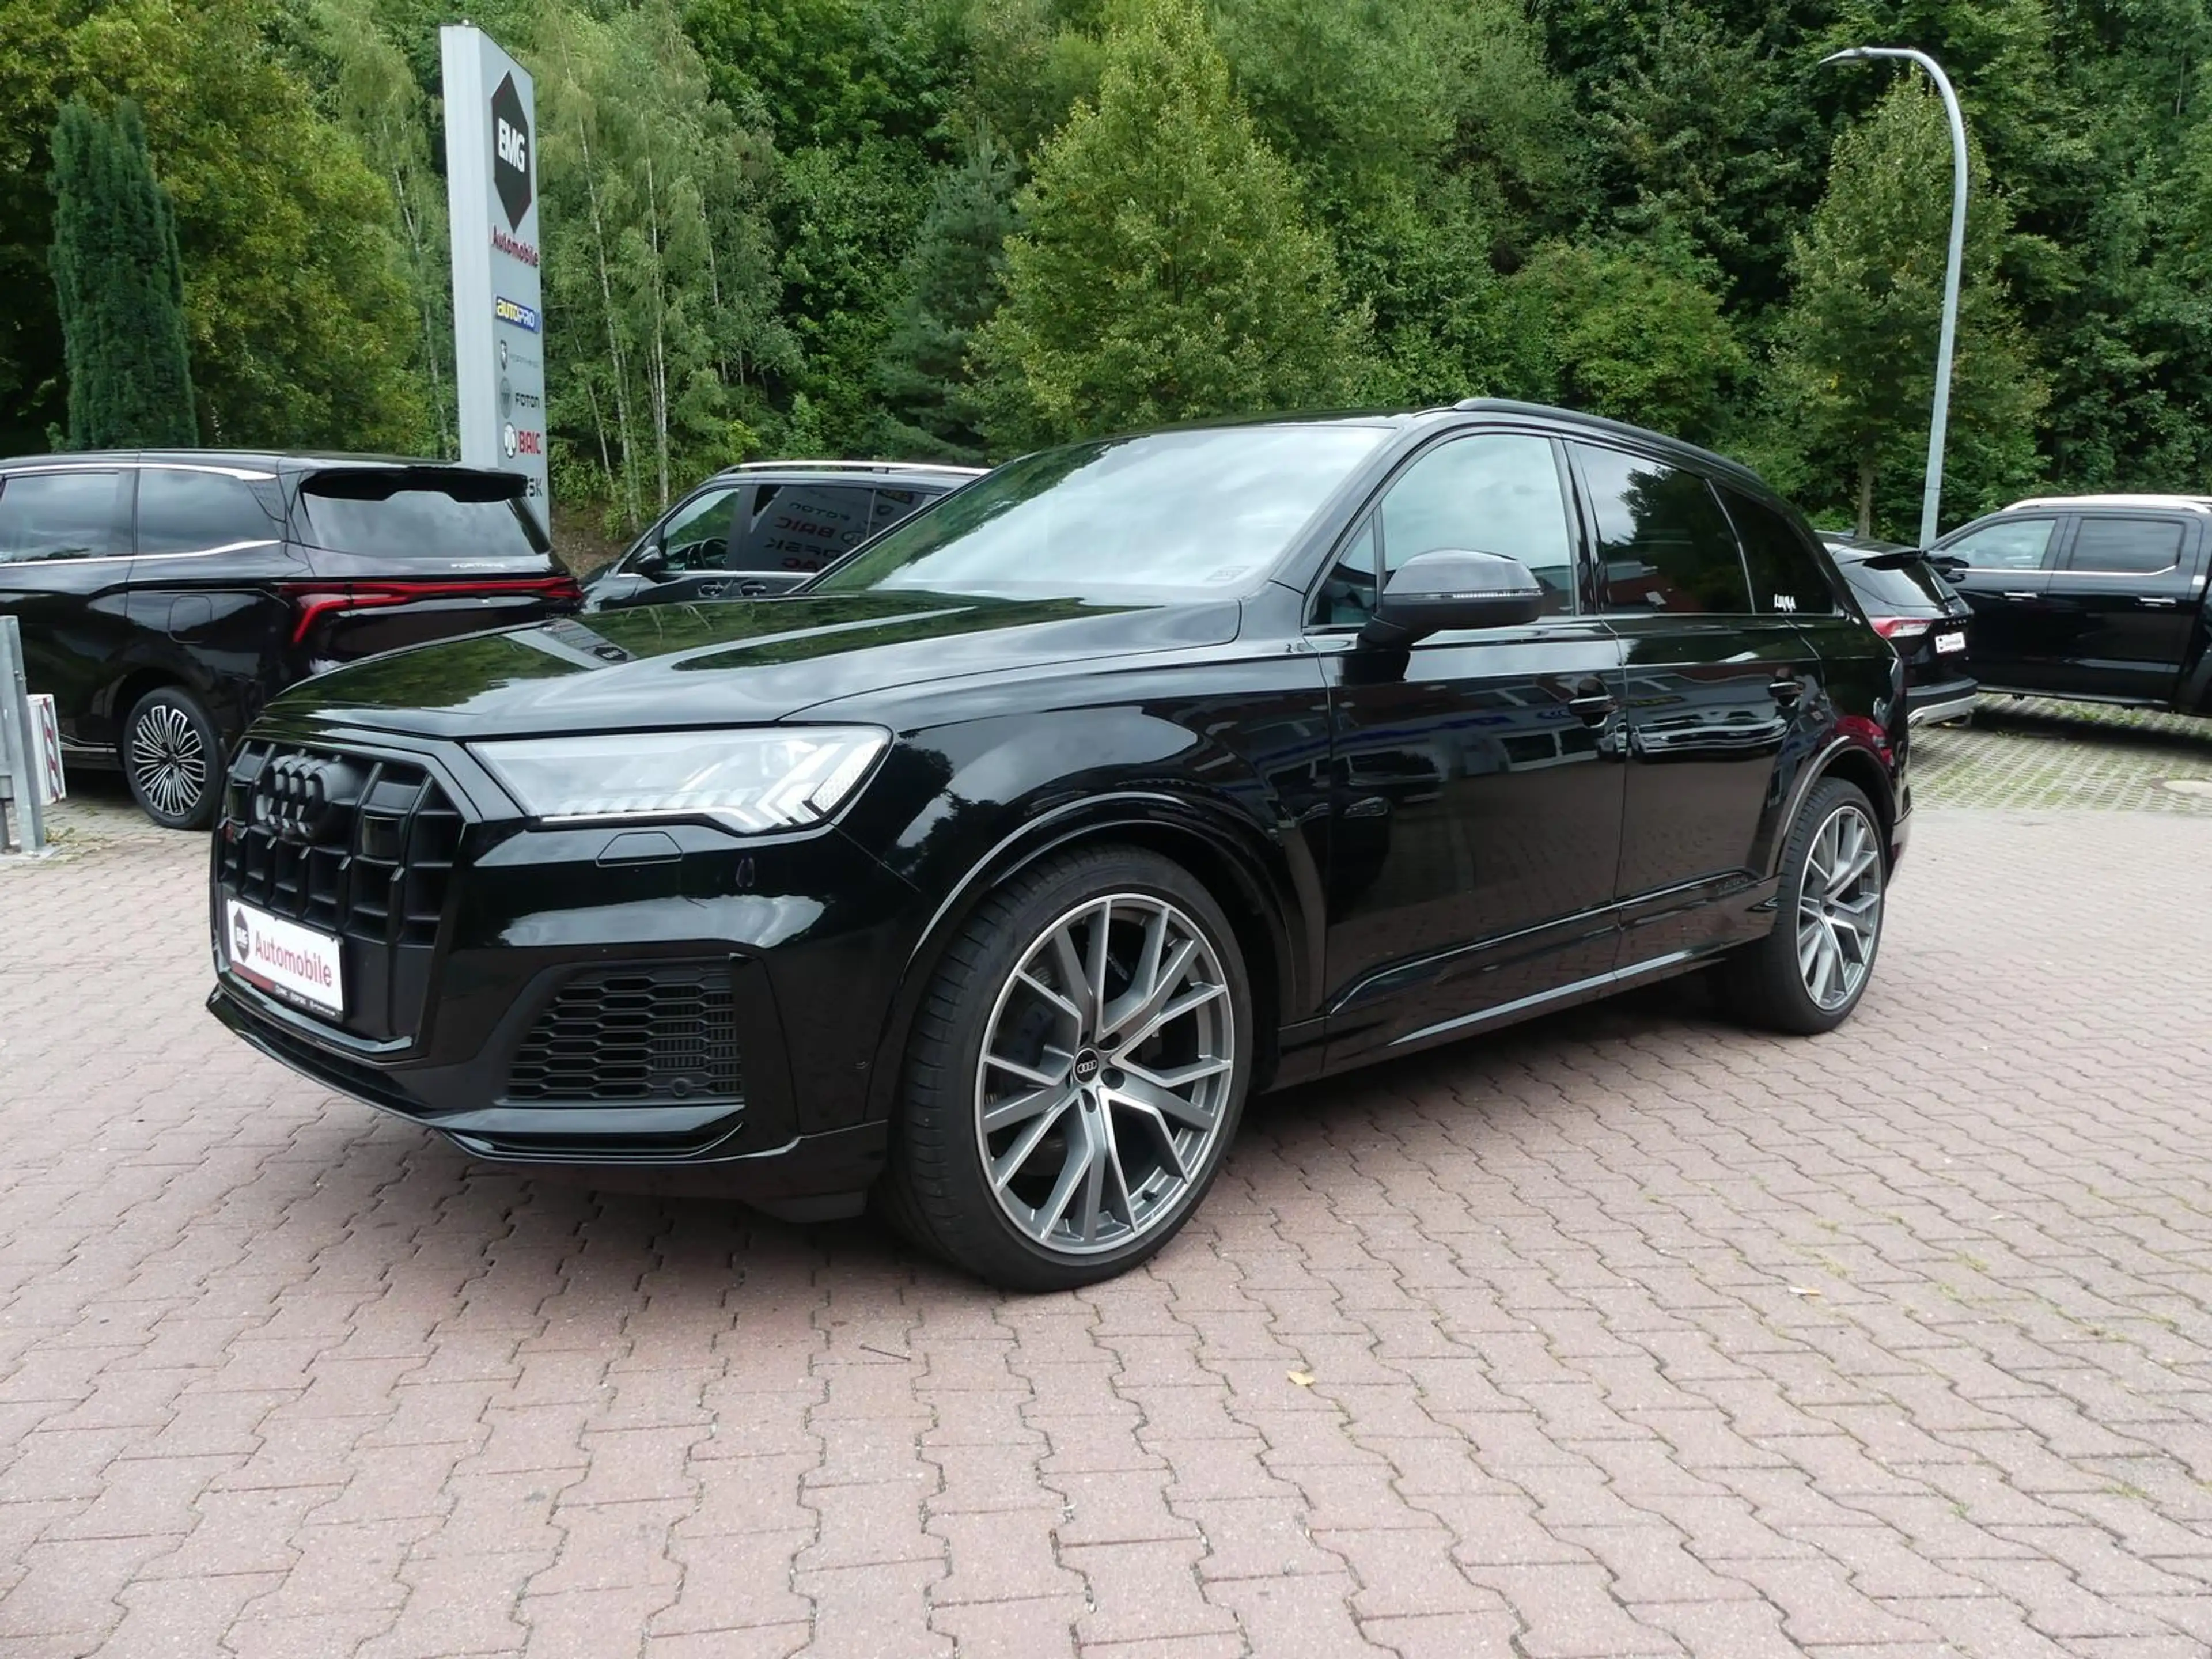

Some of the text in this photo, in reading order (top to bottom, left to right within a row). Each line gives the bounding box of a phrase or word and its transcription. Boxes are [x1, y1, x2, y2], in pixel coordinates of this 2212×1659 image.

[498, 117, 525, 172] EMG
[492, 225, 538, 268] Automobile
[520, 431, 541, 454] BAIC
[525, 478, 543, 497] SK
[255, 930, 332, 987] Automobile
